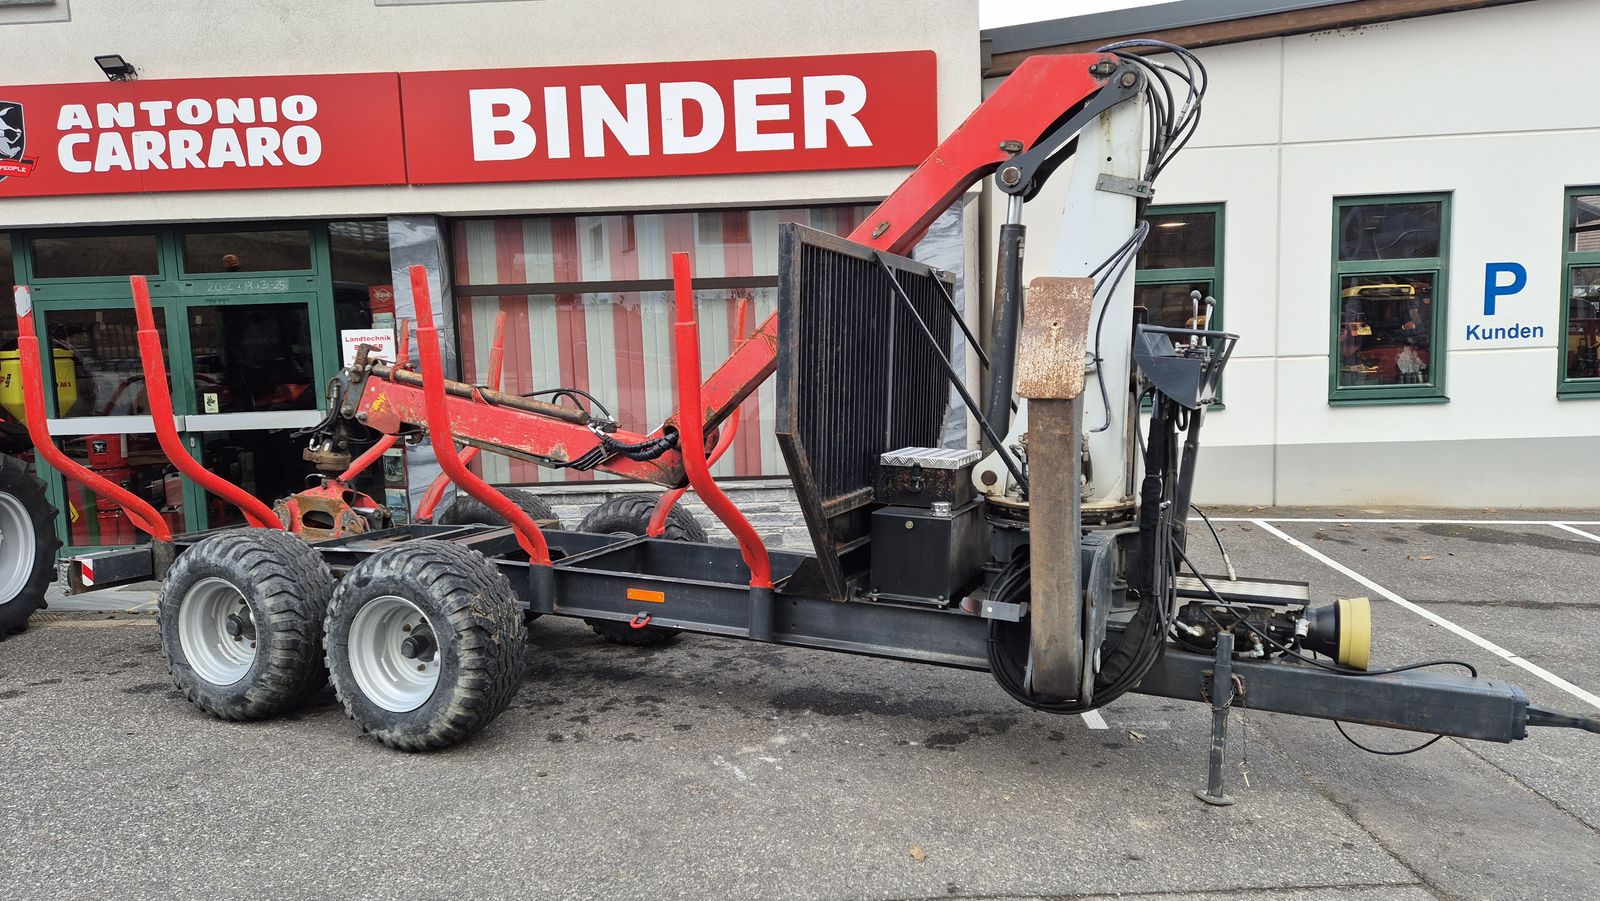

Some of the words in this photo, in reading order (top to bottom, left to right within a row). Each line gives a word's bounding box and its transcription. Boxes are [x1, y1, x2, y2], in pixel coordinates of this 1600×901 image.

[57, 94, 318, 131] ANTONIO
[469, 75, 874, 162] BINDER
[58, 125, 322, 174] CARRARO
[1483, 261, 1527, 316] P
[344, 335, 392, 343] Landtechnik
[1465, 323, 1544, 340] Kunden
